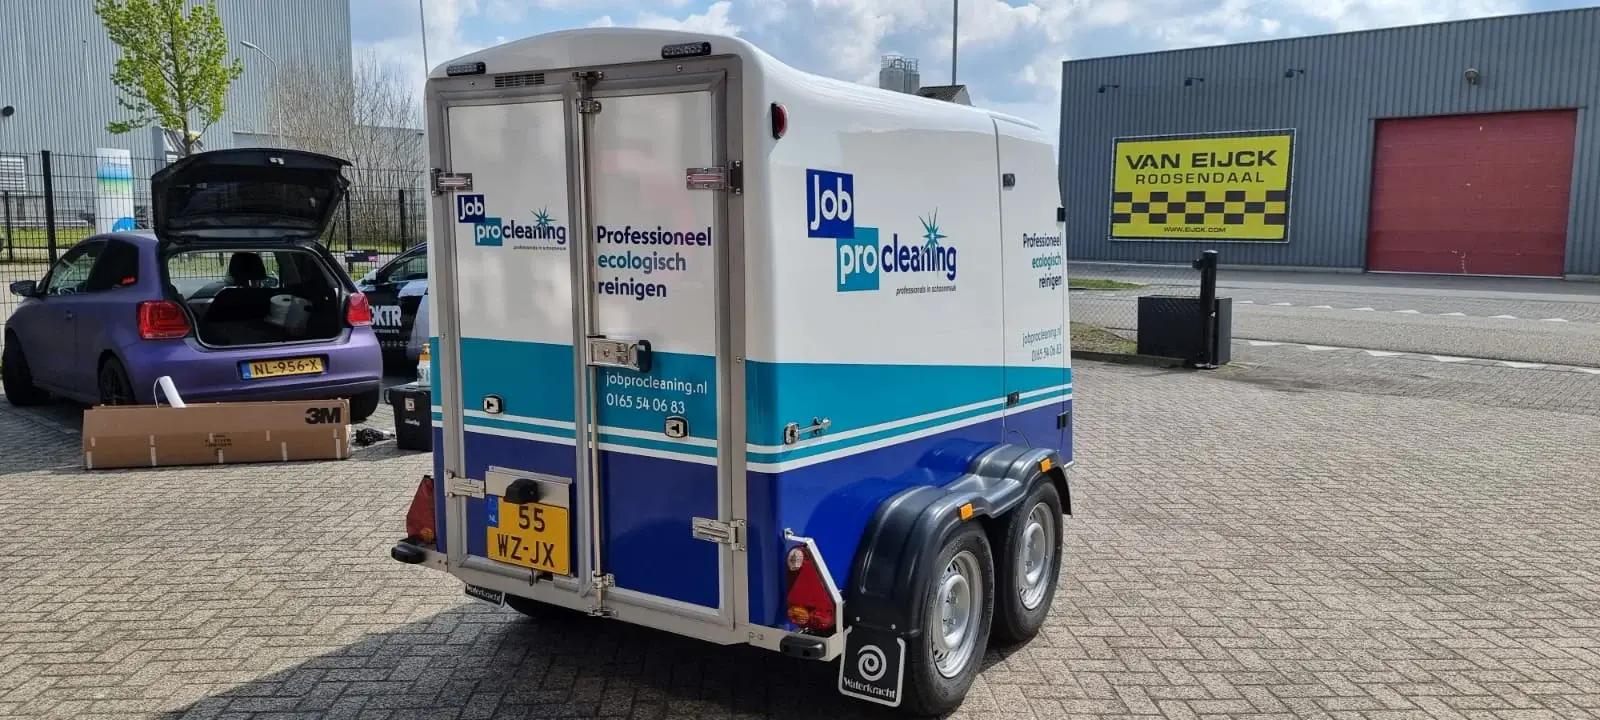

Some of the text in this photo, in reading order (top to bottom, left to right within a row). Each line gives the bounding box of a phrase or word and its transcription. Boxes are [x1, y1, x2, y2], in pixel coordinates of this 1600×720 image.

[1126, 150, 1277, 170] VAN EIJCK
[1135, 171, 1265, 185] ROOSENDAAL
[460, 197, 484, 220] Job
[810, 174, 852, 230] Job
[596, 225, 712, 247] Professioneel
[1023, 232, 1061, 248] Professioneel
[597, 250, 687, 275] ecologisch
[1031, 252, 1061, 270] ecologisch
[598, 276, 667, 301] reinigen
[1038, 273, 1062, 290] reinigen
[254, 359, 319, 375] NL-956-X
[606, 371, 708, 395] jobprocleaning.nl
[606, 393, 685, 414] 0165 54 06 83
[305, 407, 341, 424] 3M
[518, 505, 546, 533] 55
[497, 533, 555, 568] WZ-JX
[843, 676, 897, 699] Waterkracht
